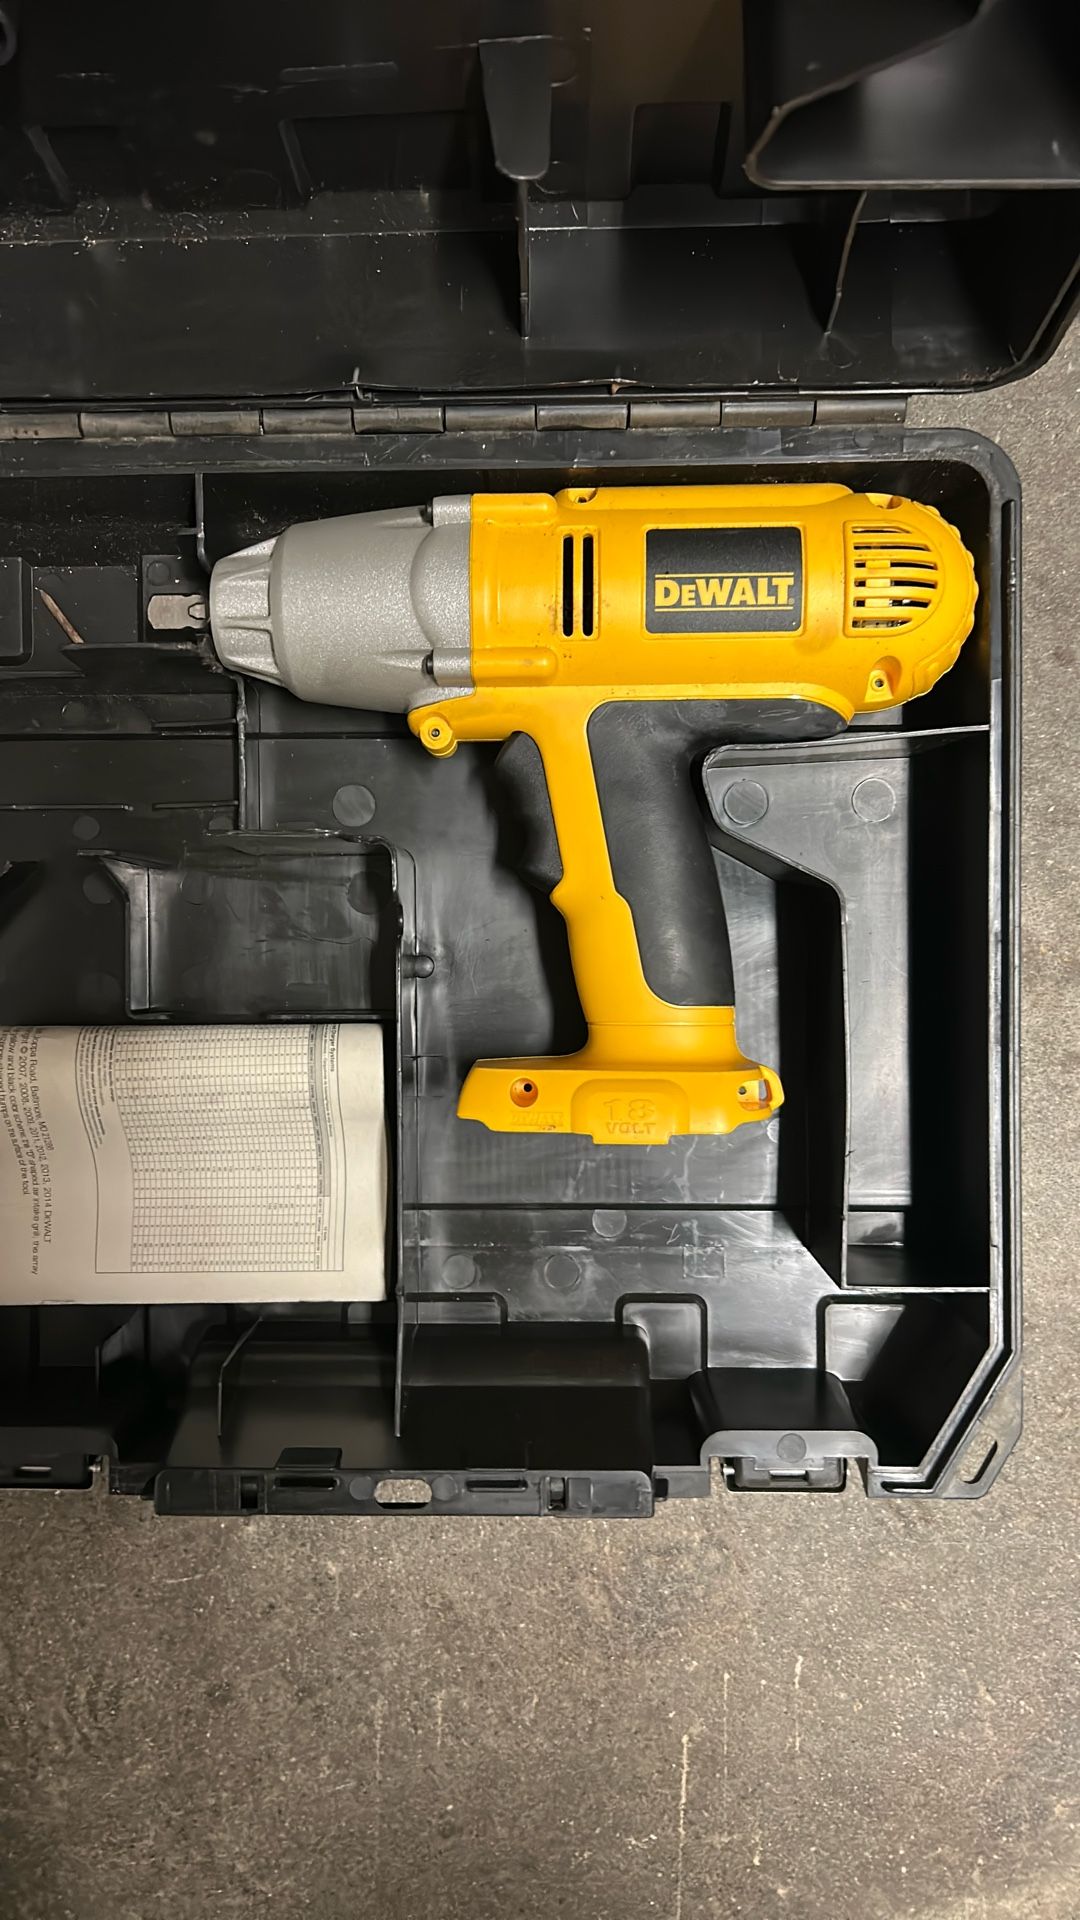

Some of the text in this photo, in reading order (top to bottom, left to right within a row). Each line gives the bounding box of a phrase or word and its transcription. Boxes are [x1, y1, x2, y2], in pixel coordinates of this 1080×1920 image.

[655, 577, 794, 607] DEWALT
[603, 1098, 655, 1121] 18
[605, 1122, 657, 1134] VOLT
[44, 1188, 52, 1208] 2014
[32, 1241, 40, 1253] the
[31, 1255, 39, 1275] array
